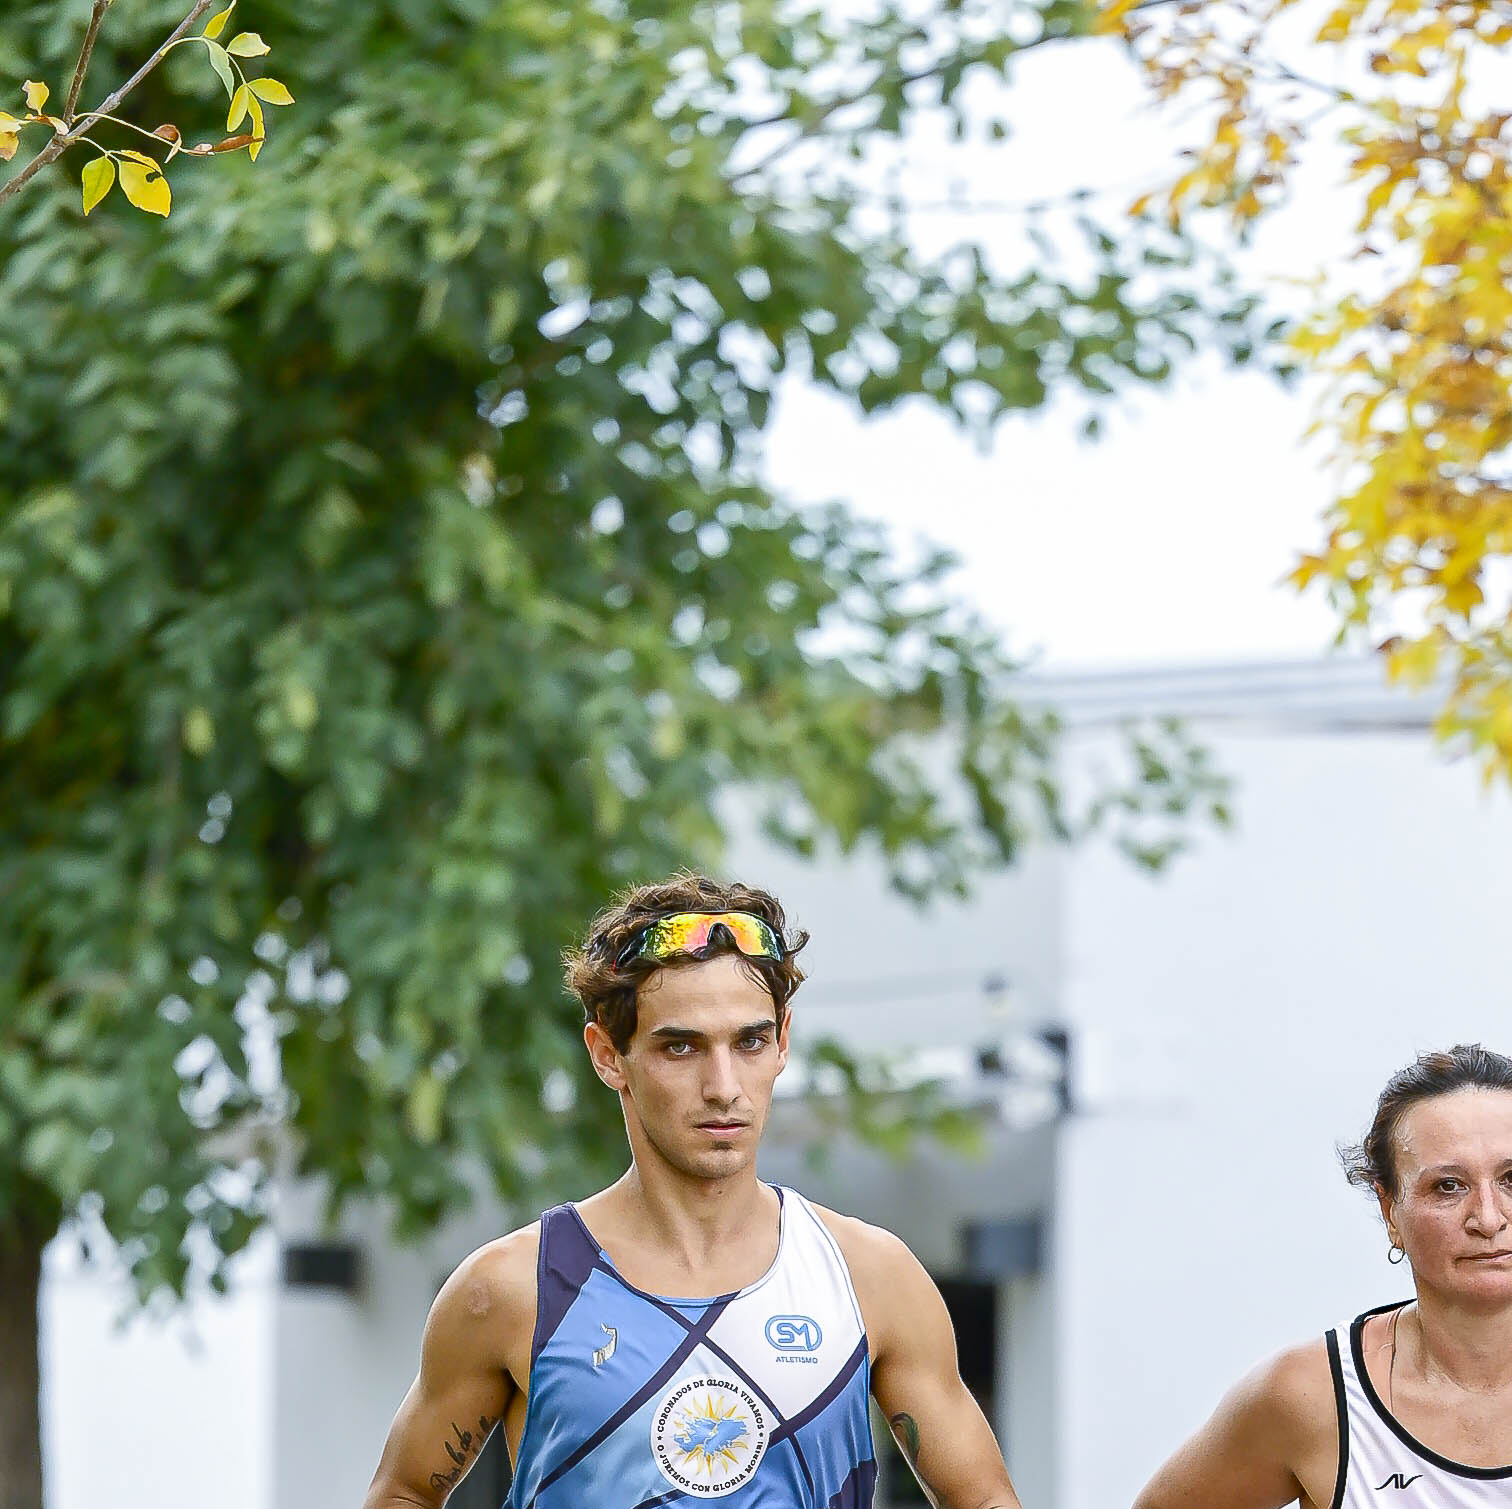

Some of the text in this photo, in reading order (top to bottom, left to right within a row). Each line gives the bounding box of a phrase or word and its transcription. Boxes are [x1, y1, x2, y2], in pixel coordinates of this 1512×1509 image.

[775, 1356, 818, 1364] ATLETISMO
[657, 1379, 765, 1432] CORONADOS DE GLORIA VIVAMOS
[657, 1444, 664, 1452] O
[660, 1454, 691, 1487] JUREMOS
[691, 1483, 710, 1492] CON
[712, 1473, 746, 1492] GLORIA
